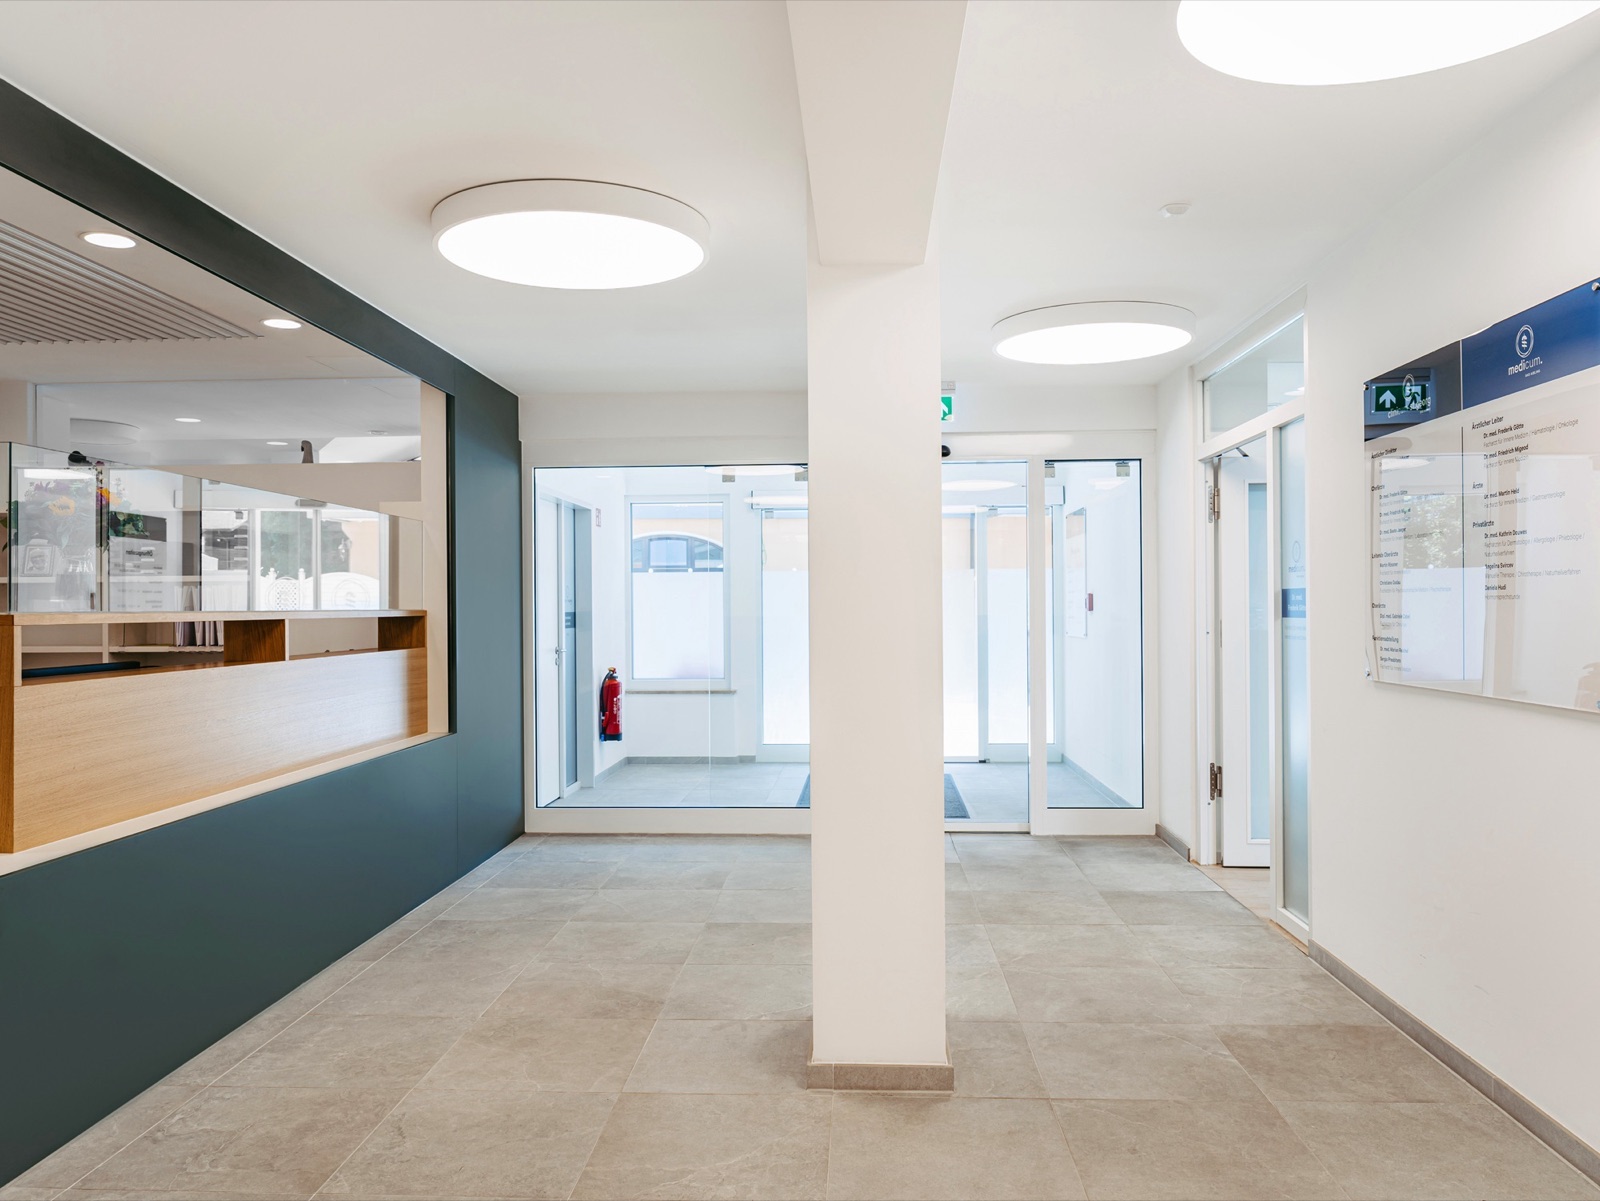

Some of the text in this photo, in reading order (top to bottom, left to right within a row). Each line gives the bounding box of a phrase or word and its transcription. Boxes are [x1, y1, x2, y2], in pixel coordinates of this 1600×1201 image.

[1508, 356, 1543, 376] medicum.
[1492, 416, 1504, 425] Leiter
[1498, 447, 1514, 456] Friedrich
